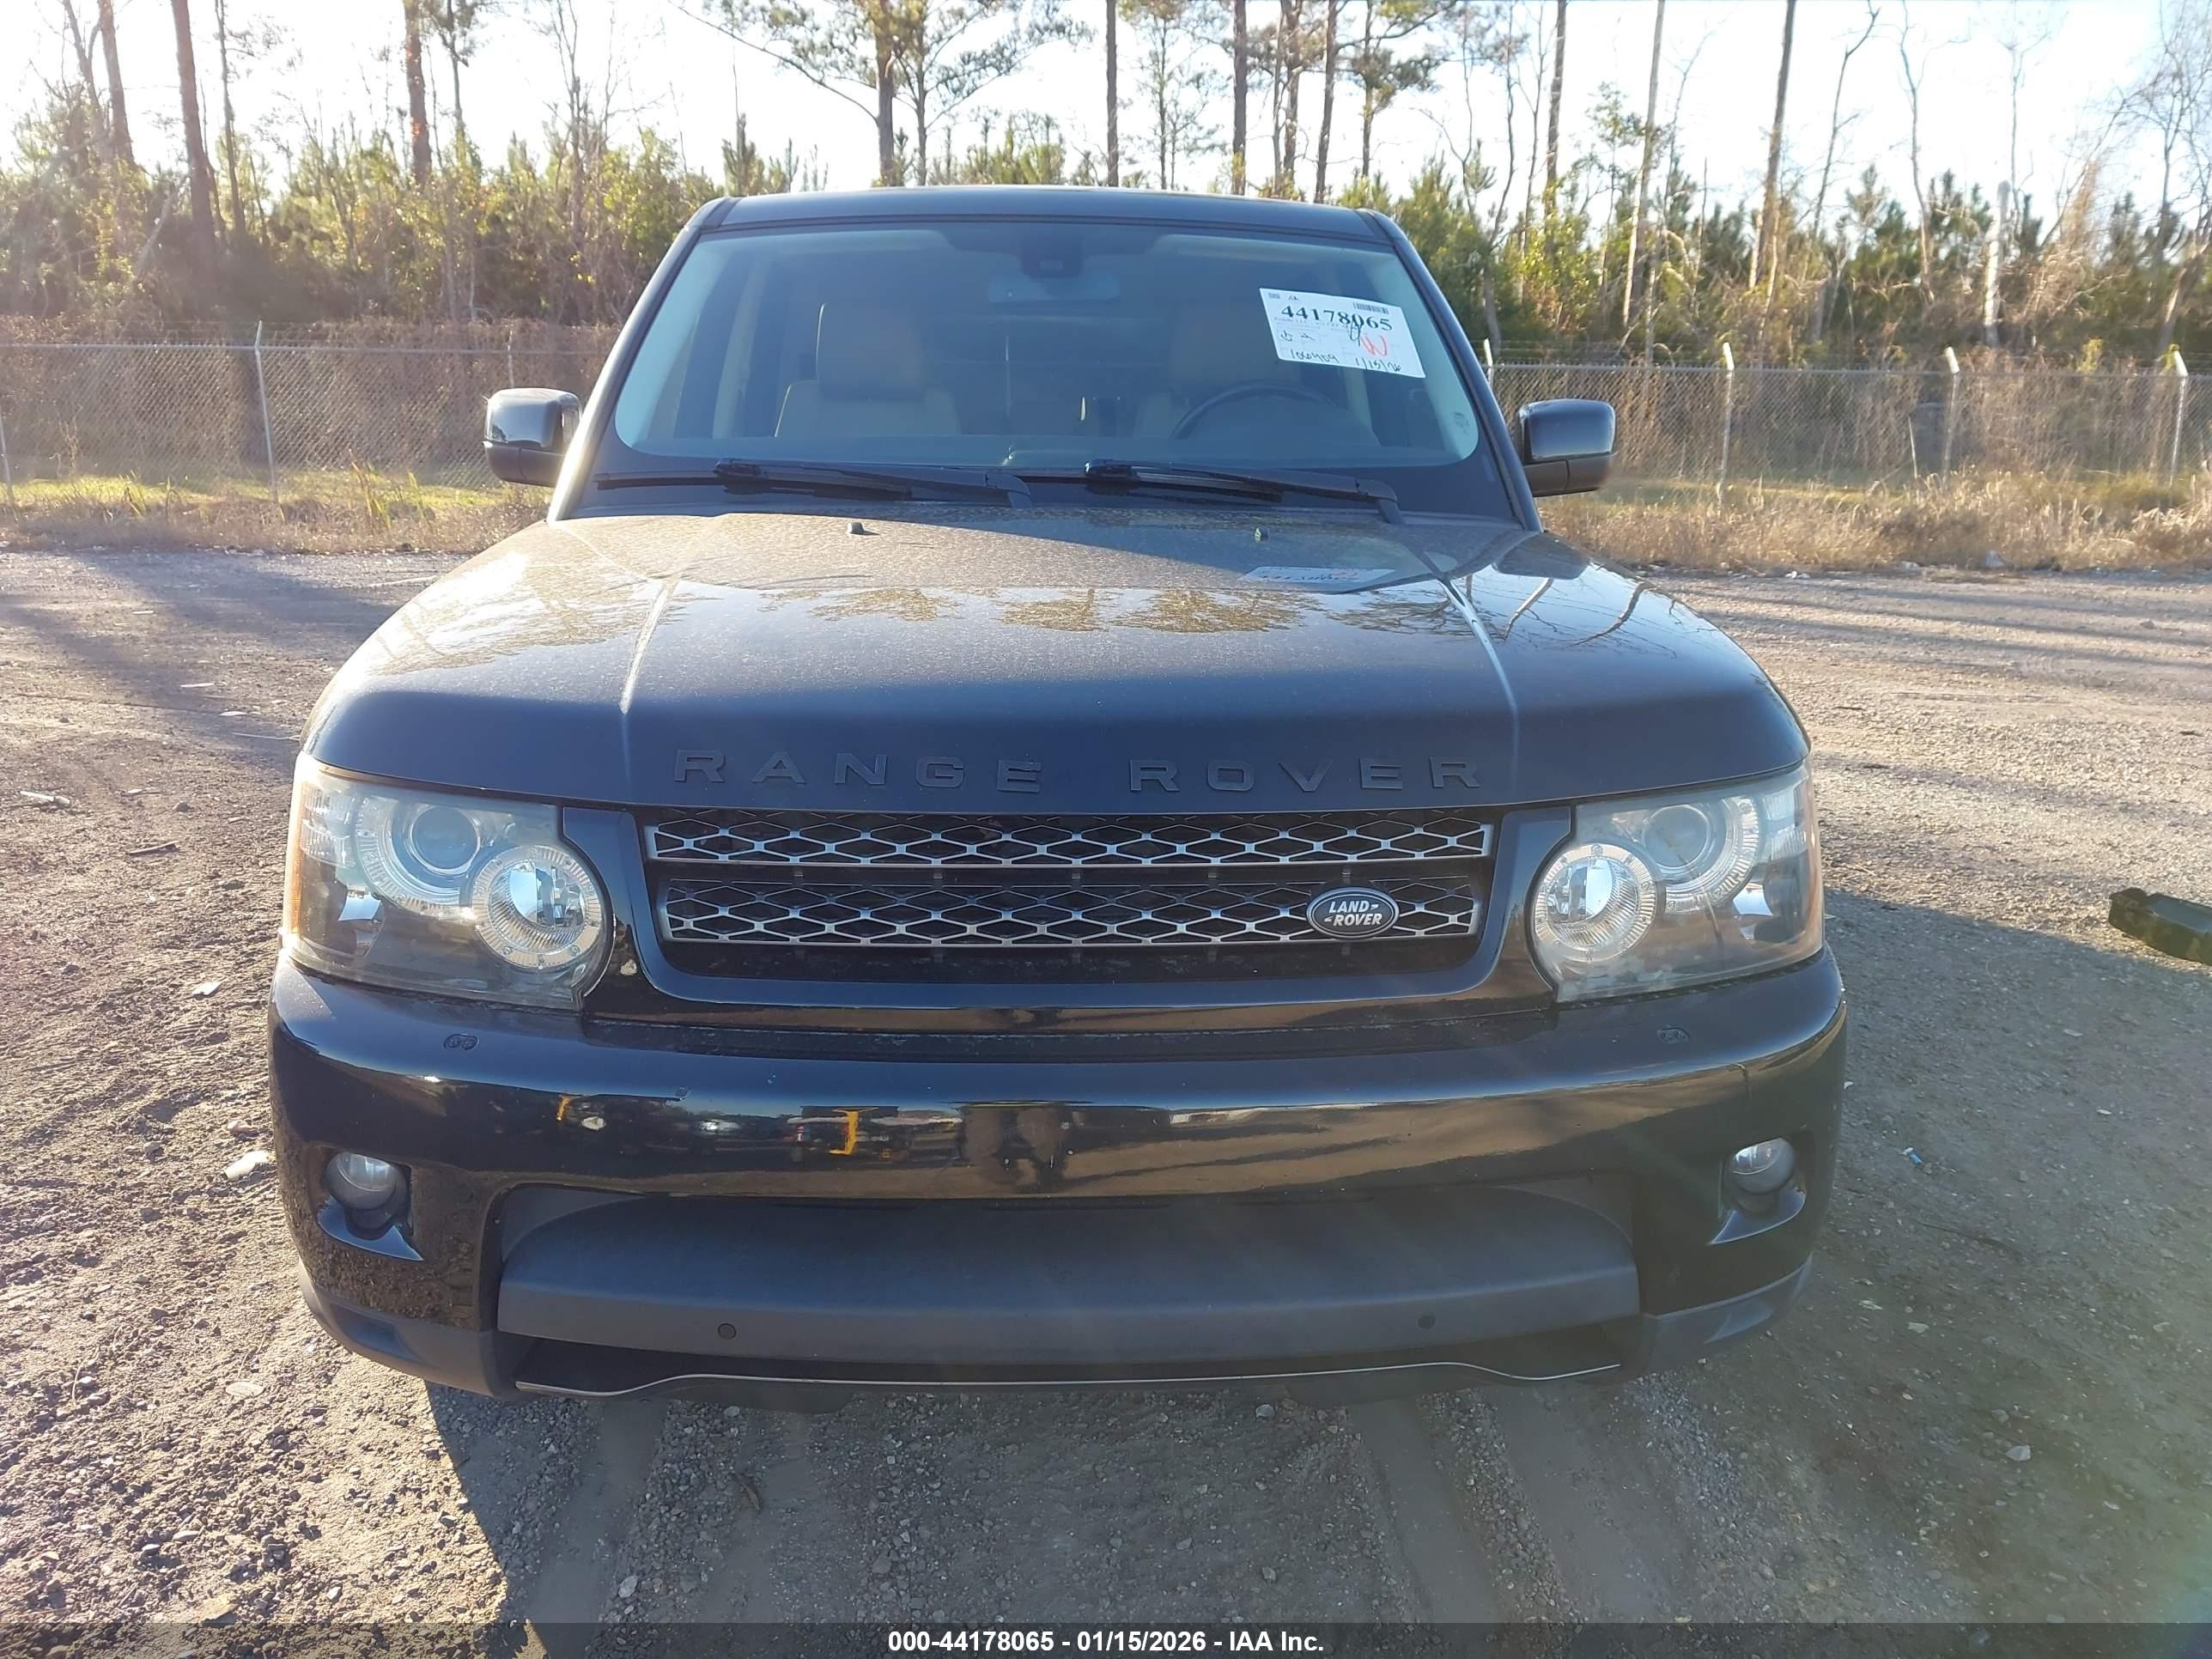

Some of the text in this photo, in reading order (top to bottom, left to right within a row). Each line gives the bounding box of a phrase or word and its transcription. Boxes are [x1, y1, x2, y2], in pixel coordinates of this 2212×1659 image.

[1281, 305, 1393, 331] 44178065
[674, 750, 1481, 793] RANGE ROVER
[1329, 900, 1370, 913] LAND
[1333, 913, 1382, 927] ROVER
